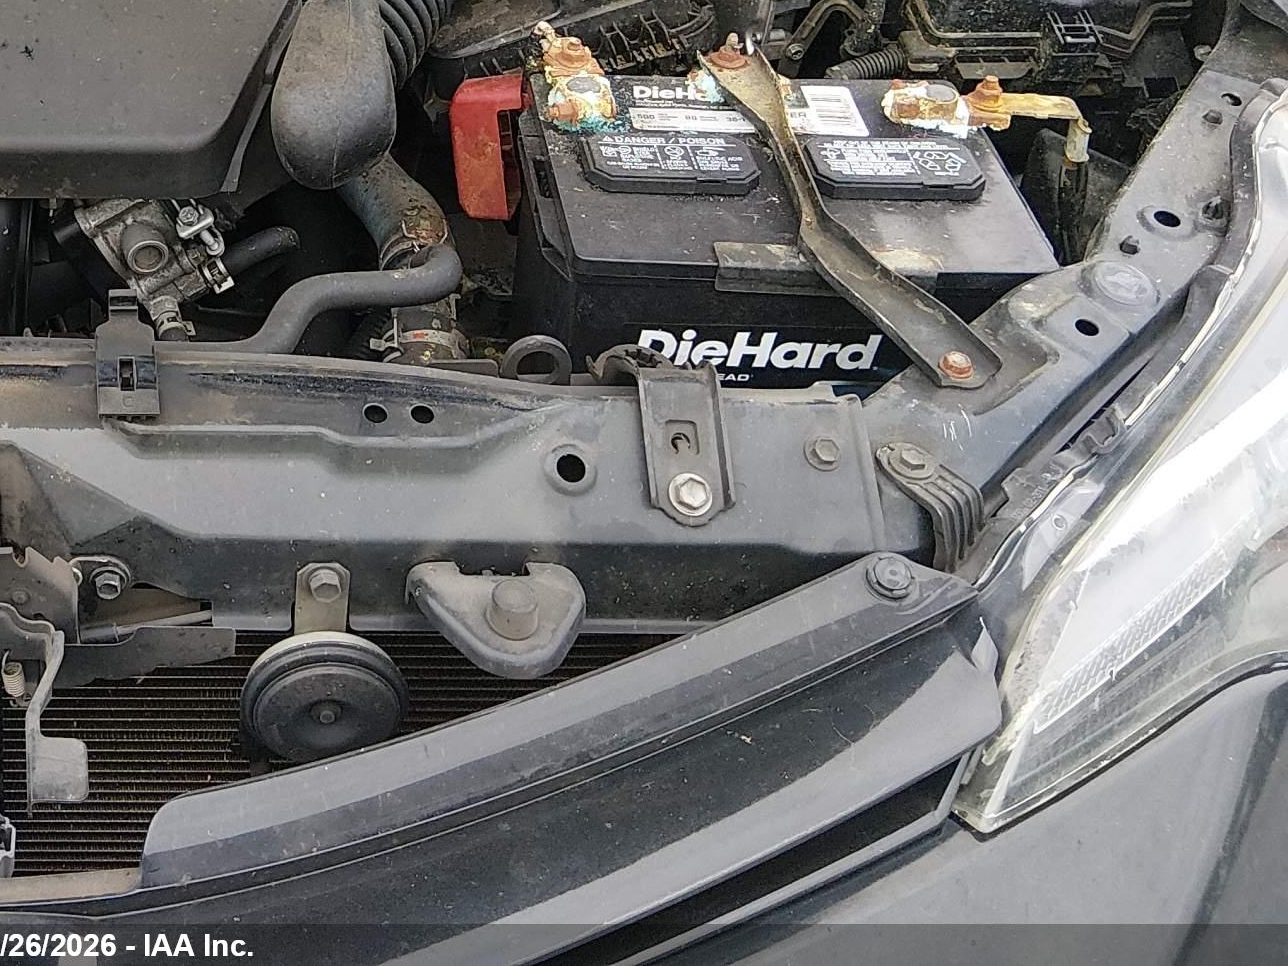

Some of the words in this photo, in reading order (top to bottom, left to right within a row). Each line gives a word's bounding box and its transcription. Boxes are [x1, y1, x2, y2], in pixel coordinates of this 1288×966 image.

[615, 136, 666, 145] DANGER
[678, 137, 726, 146] POISON
[638, 329, 884, 371] DieHard
